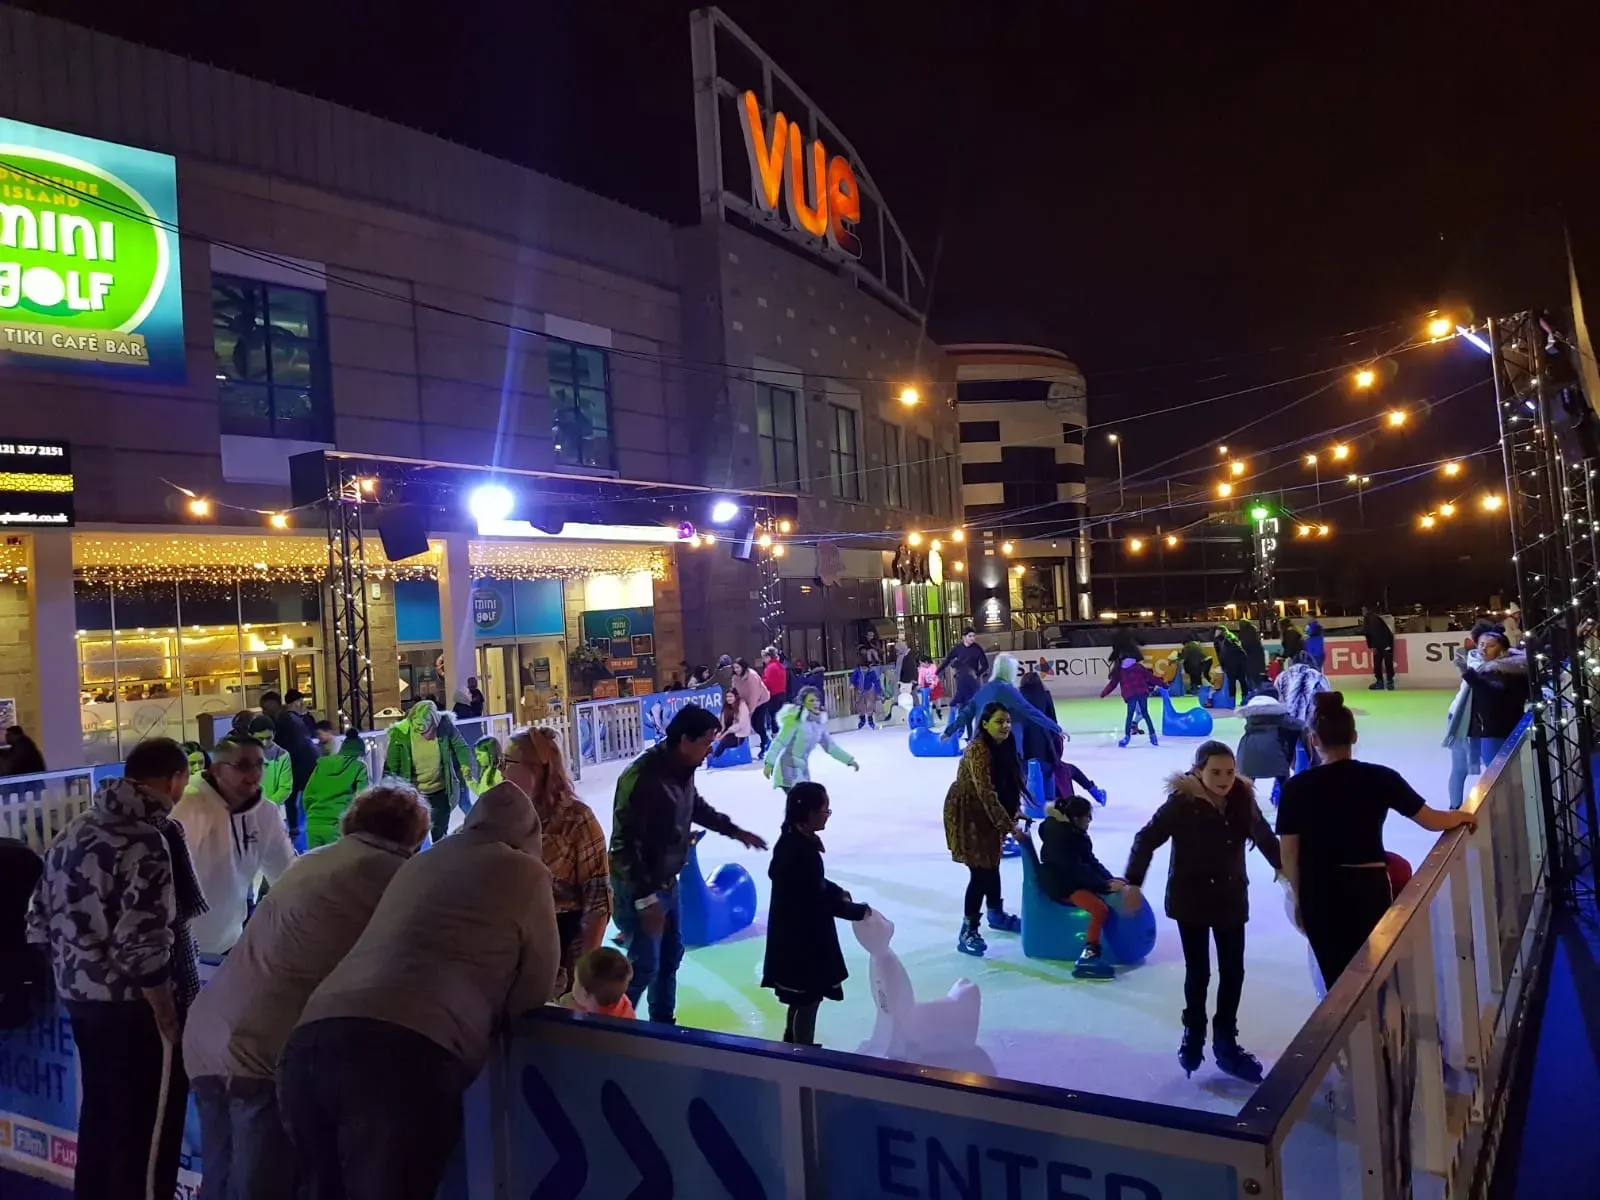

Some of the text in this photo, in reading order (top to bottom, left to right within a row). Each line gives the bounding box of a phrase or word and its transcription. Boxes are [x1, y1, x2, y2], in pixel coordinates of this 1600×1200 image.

[3, 184, 80, 208] ISLAND
[4, 328, 143, 356] TIKI CAFÉ BAR
[0, 444, 63, 456] 21 327 2151
[1331, 647, 1398, 670] Fu.
